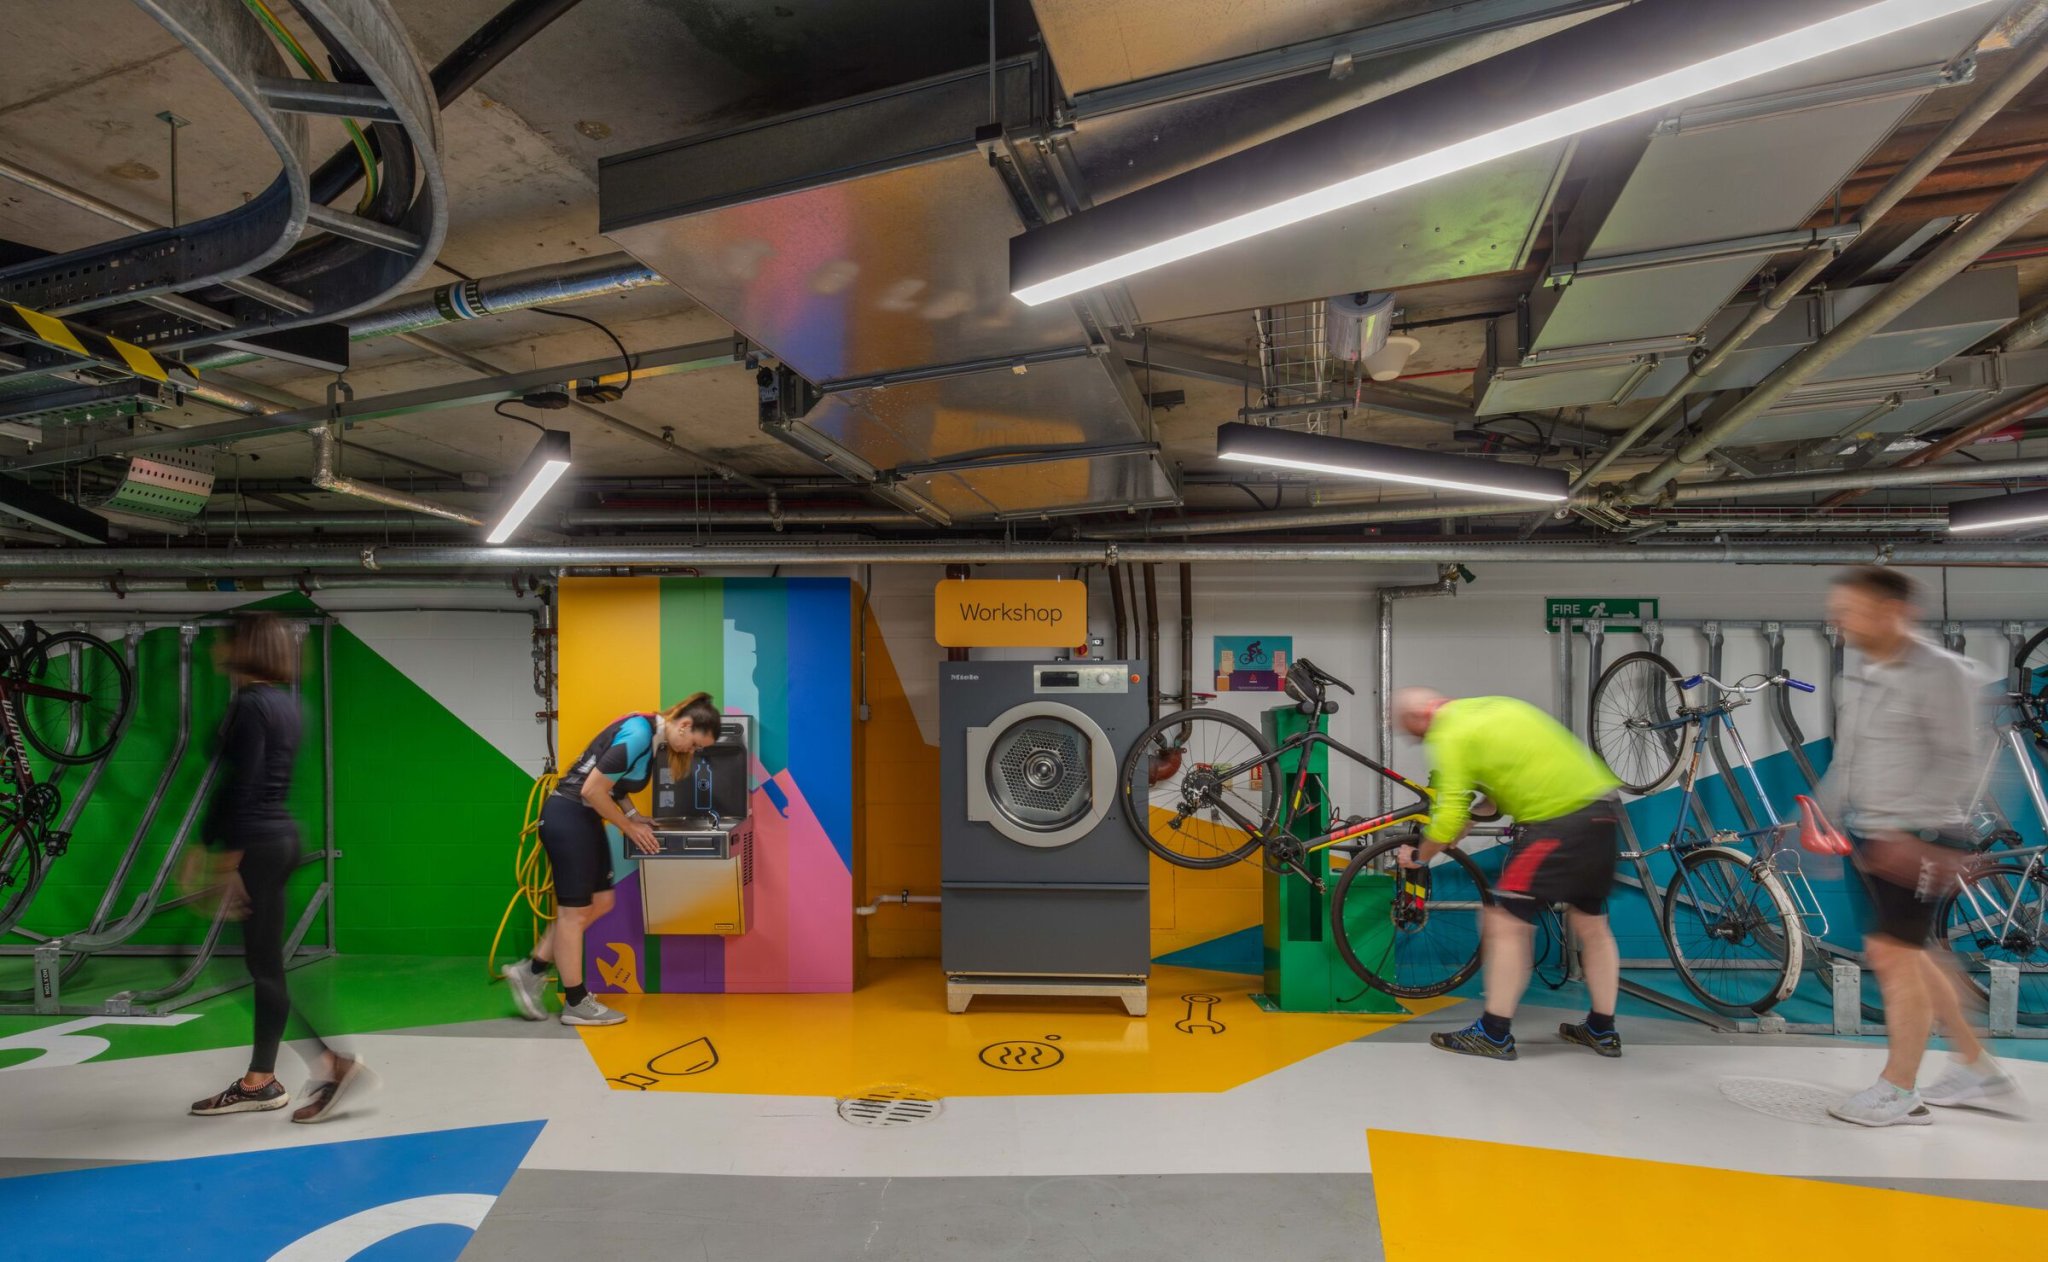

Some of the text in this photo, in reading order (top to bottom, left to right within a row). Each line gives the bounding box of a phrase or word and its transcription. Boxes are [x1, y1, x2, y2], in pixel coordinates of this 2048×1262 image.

[959, 602, 1063, 627] Workshop
[1552, 604, 1581, 615] FIRE
[2, 699, 31, 775] SPECIALIZED
